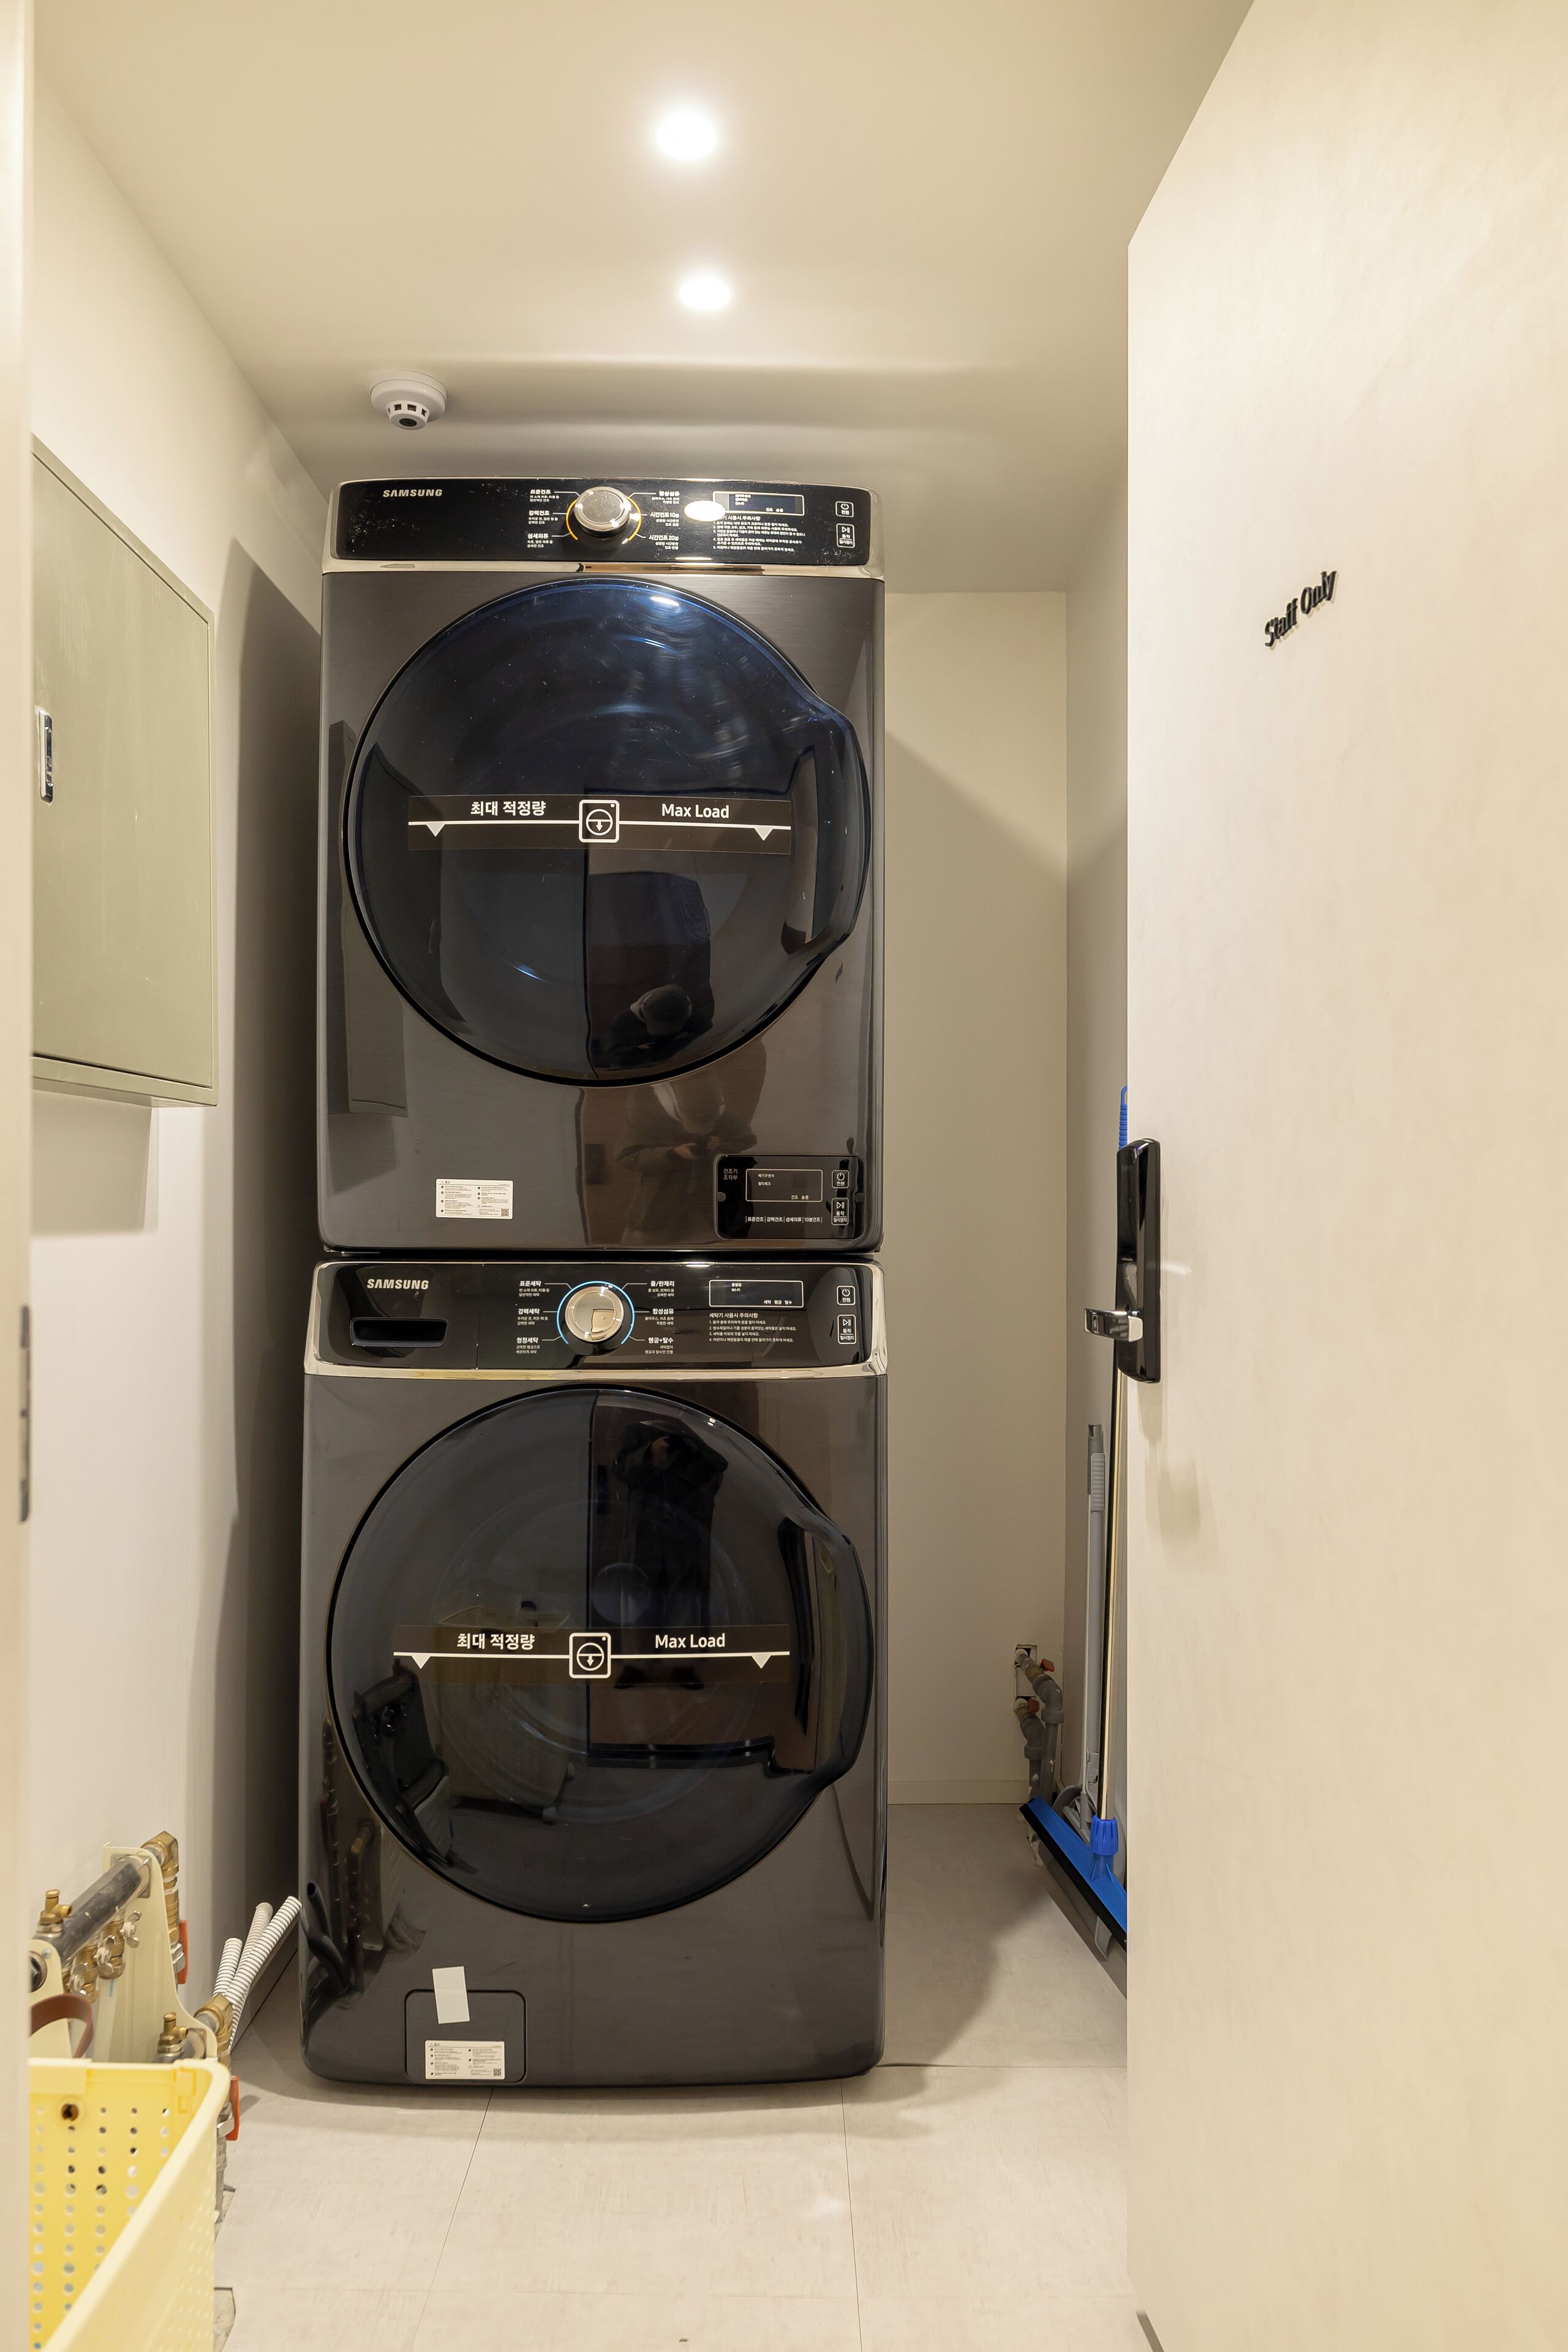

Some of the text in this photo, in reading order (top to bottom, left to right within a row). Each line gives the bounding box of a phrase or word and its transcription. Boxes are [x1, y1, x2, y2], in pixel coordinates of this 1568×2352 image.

[1265, 570, 1337, 647] Staff Only
[470, 801, 546, 816] 최대 적정량
[662, 804, 729, 818] Max Load
[368, 1279, 429, 1290] SAMSUNG
[457, 1634, 535, 1650] 최대 적정량
[655, 1634, 725, 1649] Max Load
